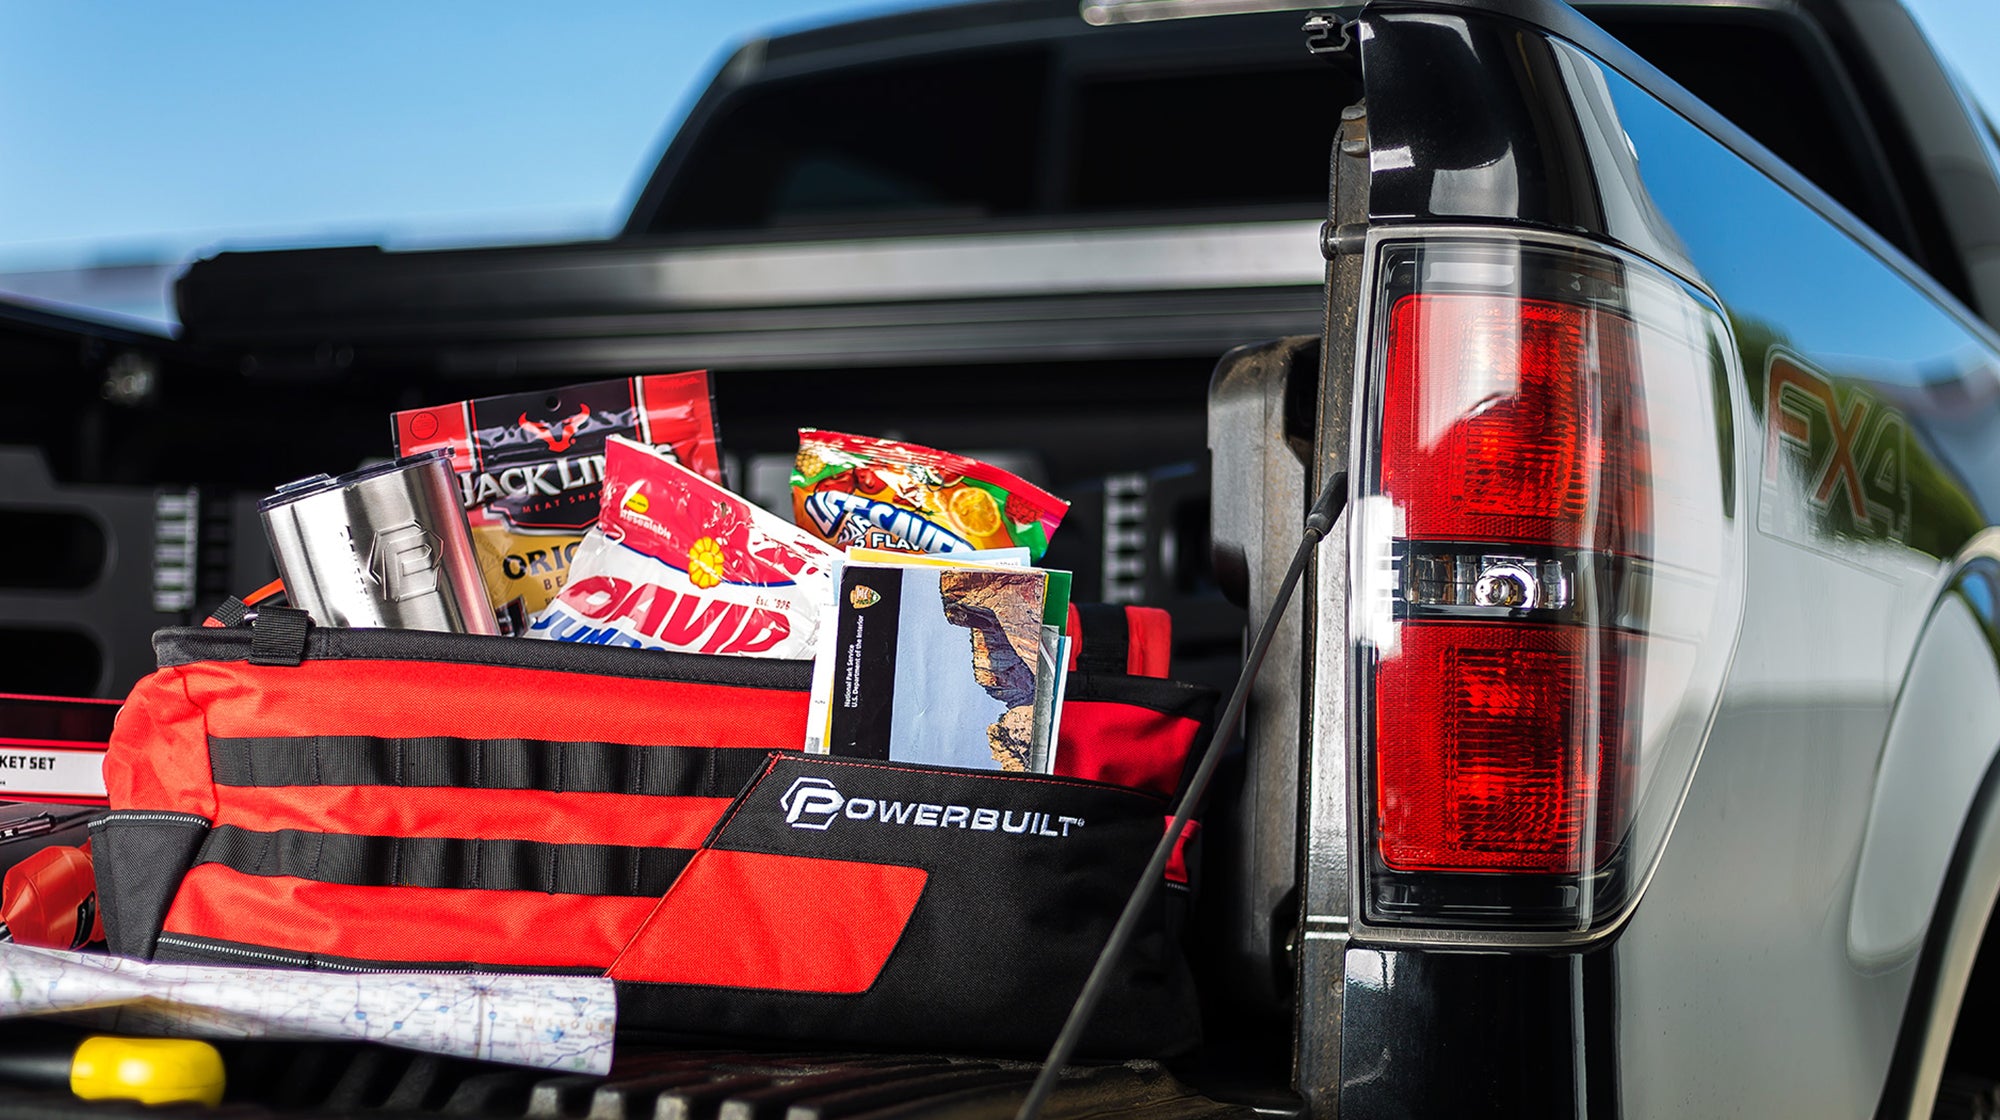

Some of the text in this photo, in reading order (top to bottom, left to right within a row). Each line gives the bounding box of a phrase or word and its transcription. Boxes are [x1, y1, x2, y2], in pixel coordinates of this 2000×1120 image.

[1760, 346, 1910, 541] FX4
[463, 463, 562, 508] JACK
[522, 499, 561, 513] MEAT
[621, 508, 672, 540] Resealable
[854, 536, 866, 548] 5
[556, 575, 791, 654] DAVID
[856, 614, 864, 638] Interior
[855, 638, 863, 649] the
[844, 644, 854, 707] National Park Service
[852, 658, 861, 694] Department
[851, 695, 859, 708] U.S.
[29, 756, 56, 770] SET
